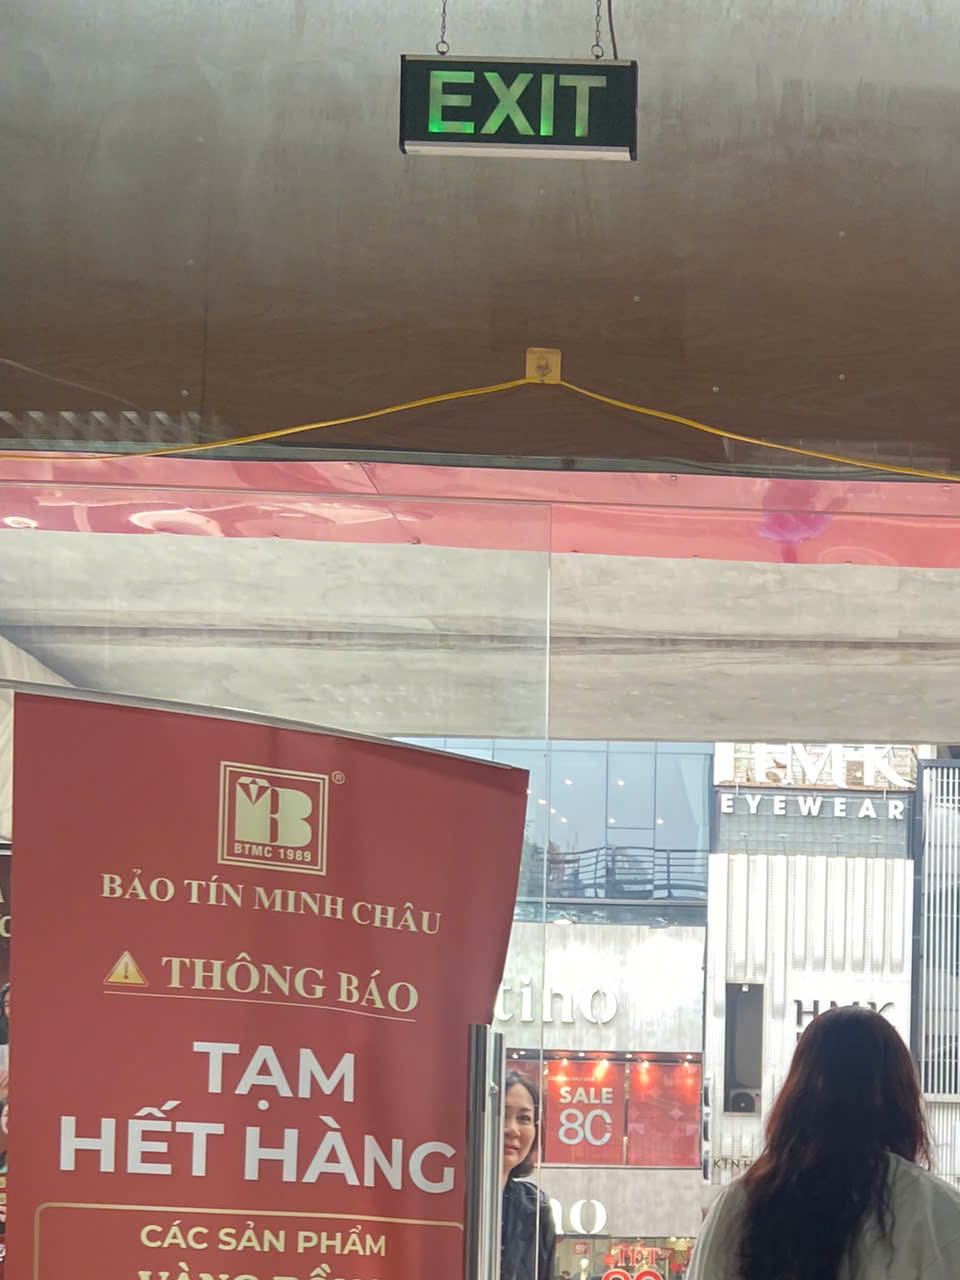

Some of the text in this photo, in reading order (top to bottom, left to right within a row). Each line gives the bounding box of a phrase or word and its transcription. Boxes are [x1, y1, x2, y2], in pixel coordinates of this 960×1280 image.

[428, 70, 607, 137] EXIT
[720, 794, 905, 819] EYEWEAR
[234, 843, 312, 862] BTMC 1989
[101, 869, 441, 934] BẢO TÍN MINH CHÂU
[162, 953, 418, 1013] THÔNG BÁO
[193, 1041, 355, 1110] TẠM
[559, 1087, 613, 1104] SALE
[59, 1101, 456, 1193] HẾT HÀNG
[140, 1220, 386, 1256] CÁC SẢN PHẨM
